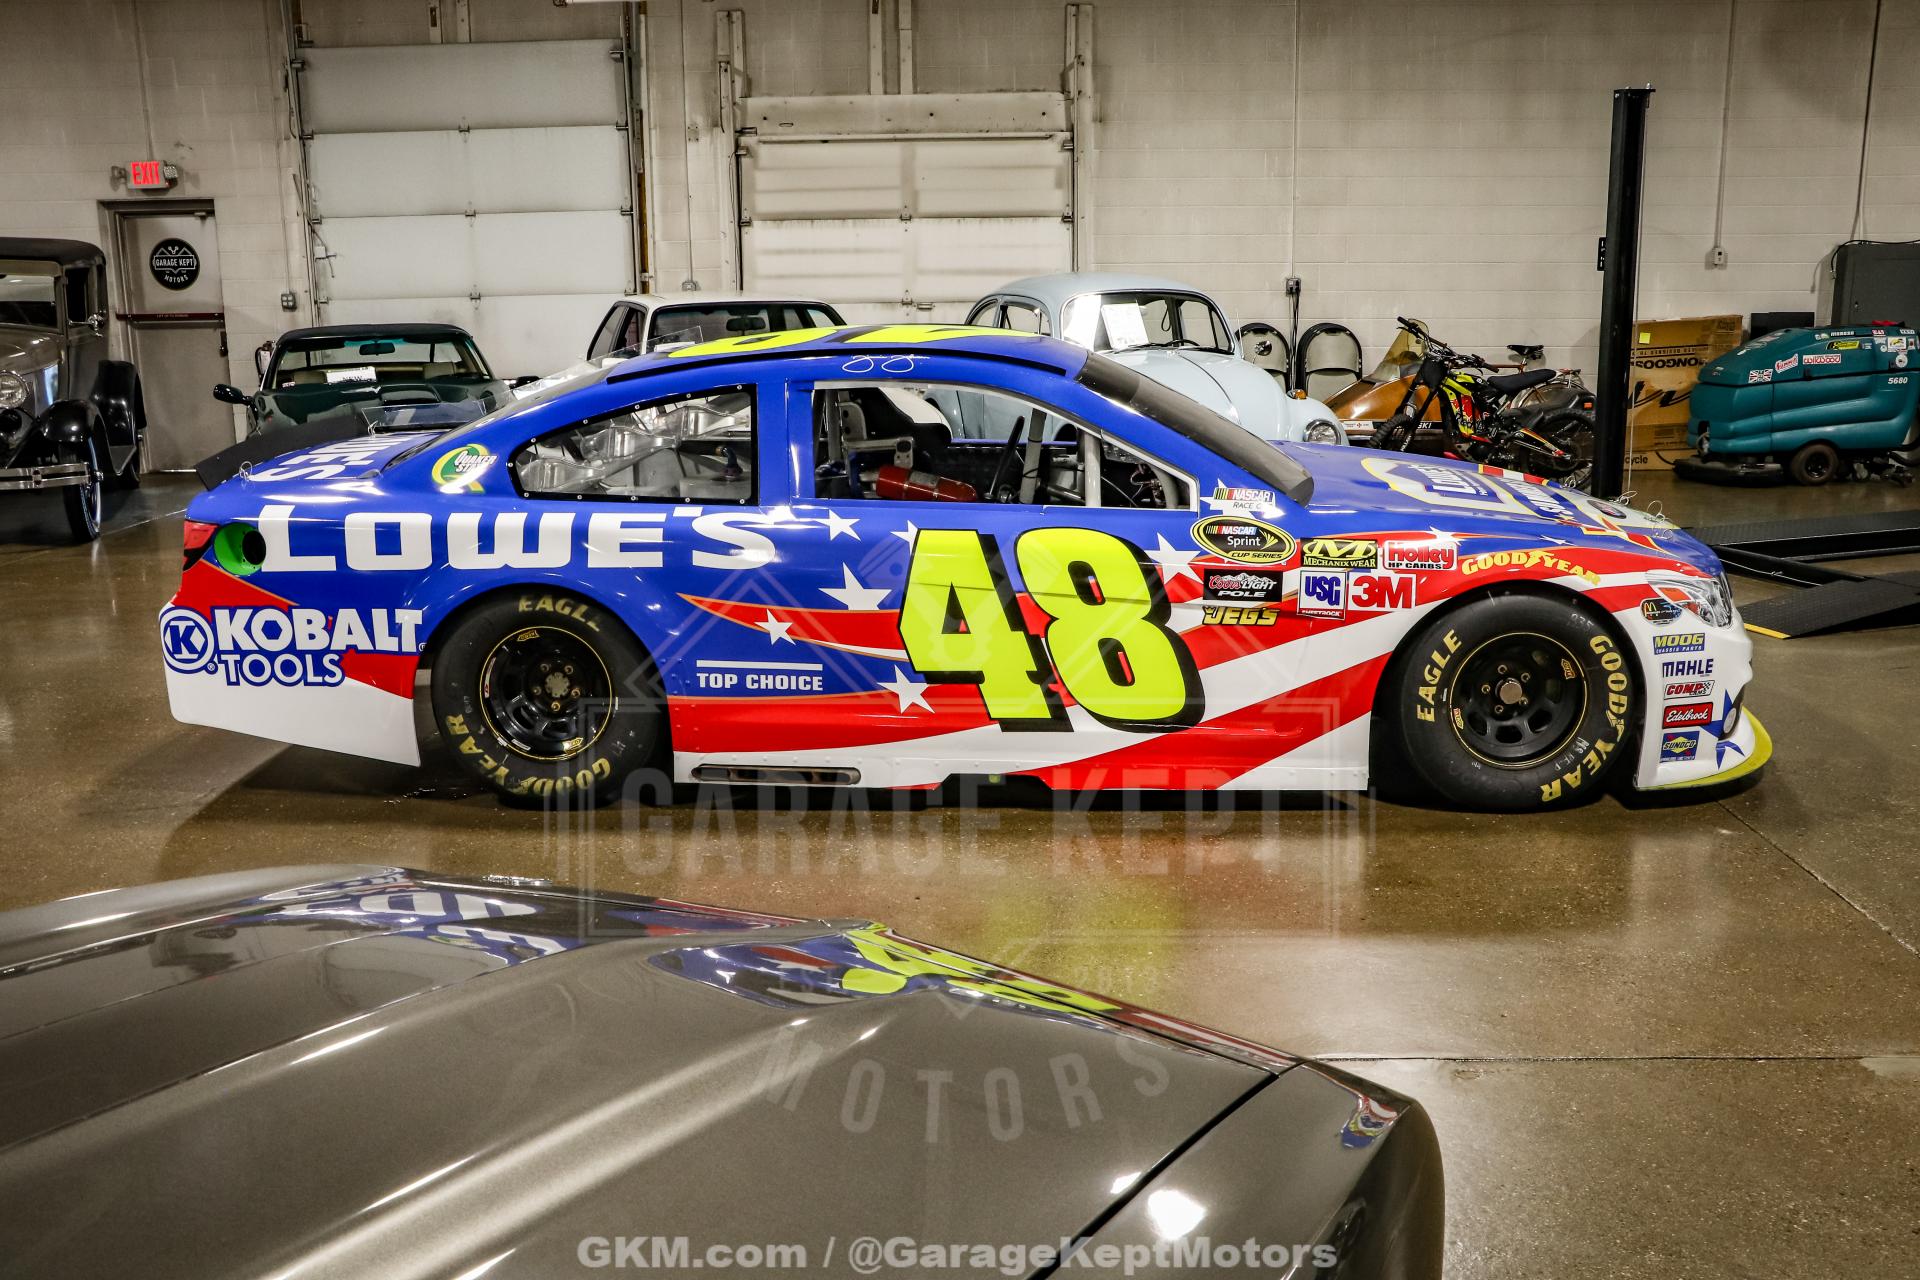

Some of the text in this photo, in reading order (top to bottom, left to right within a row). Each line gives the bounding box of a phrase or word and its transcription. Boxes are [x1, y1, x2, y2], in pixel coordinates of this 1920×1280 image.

[131, 161, 160, 185] EXIT
[155, 258, 194, 267] GARAGE KEPT
[164, 273, 189, 284] MOTORS
[1888, 377, 1908, 385] 5680
[455, 450, 498, 465] QUAKER
[1232, 489, 1271, 502] NASCAR
[1221, 526, 1255, 535] NASCAR
[261, 505, 777, 572] LOWE'S
[1228, 536, 1260, 548] Sprint
[1303, 556, 1376, 567] MECHANIX WEAR
[1388, 541, 1454, 569] Holley
[1461, 550, 1601, 586] GOODYEAR
[1209, 575, 1277, 590] Coors LIGHT
[1218, 590, 1267, 598] POLE
[1305, 576, 1342, 606] USG
[1351, 575, 1412, 608] 3M
[214, 608, 423, 653] KOBALT
[899, 527, 1206, 734] 48
[1655, 633, 1705, 649] MOOG
[220, 653, 344, 685] TOOLS
[1416, 629, 1462, 722] EAGLE
[1662, 658, 1714, 678] MAHLE
[696, 673, 823, 692] TOP CHOICE
[1667, 682, 1705, 696] COMP
[1666, 708, 1709, 723] Edelbrock
[1662, 740, 1697, 751] SUNOCO
